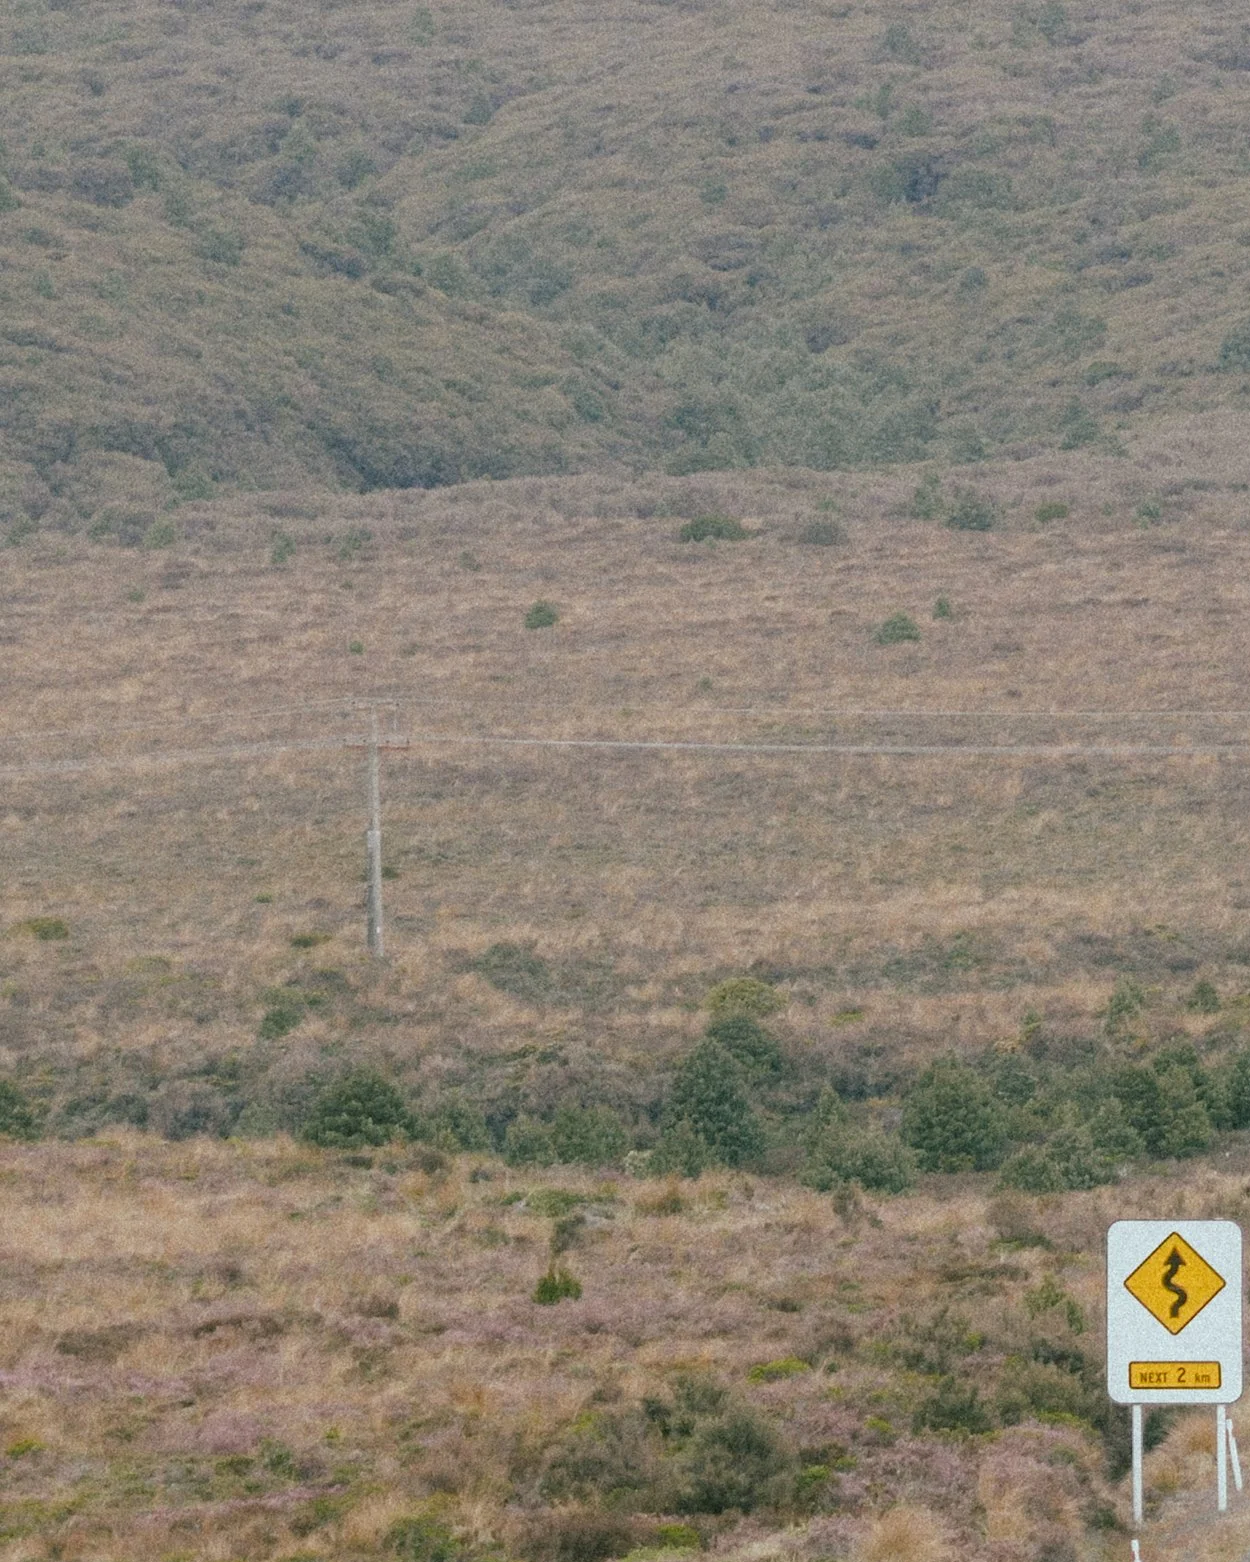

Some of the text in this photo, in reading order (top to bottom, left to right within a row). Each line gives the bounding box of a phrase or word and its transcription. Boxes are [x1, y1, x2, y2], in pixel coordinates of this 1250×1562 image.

[1139, 1367, 1210, 1383] NEXT 2 km
